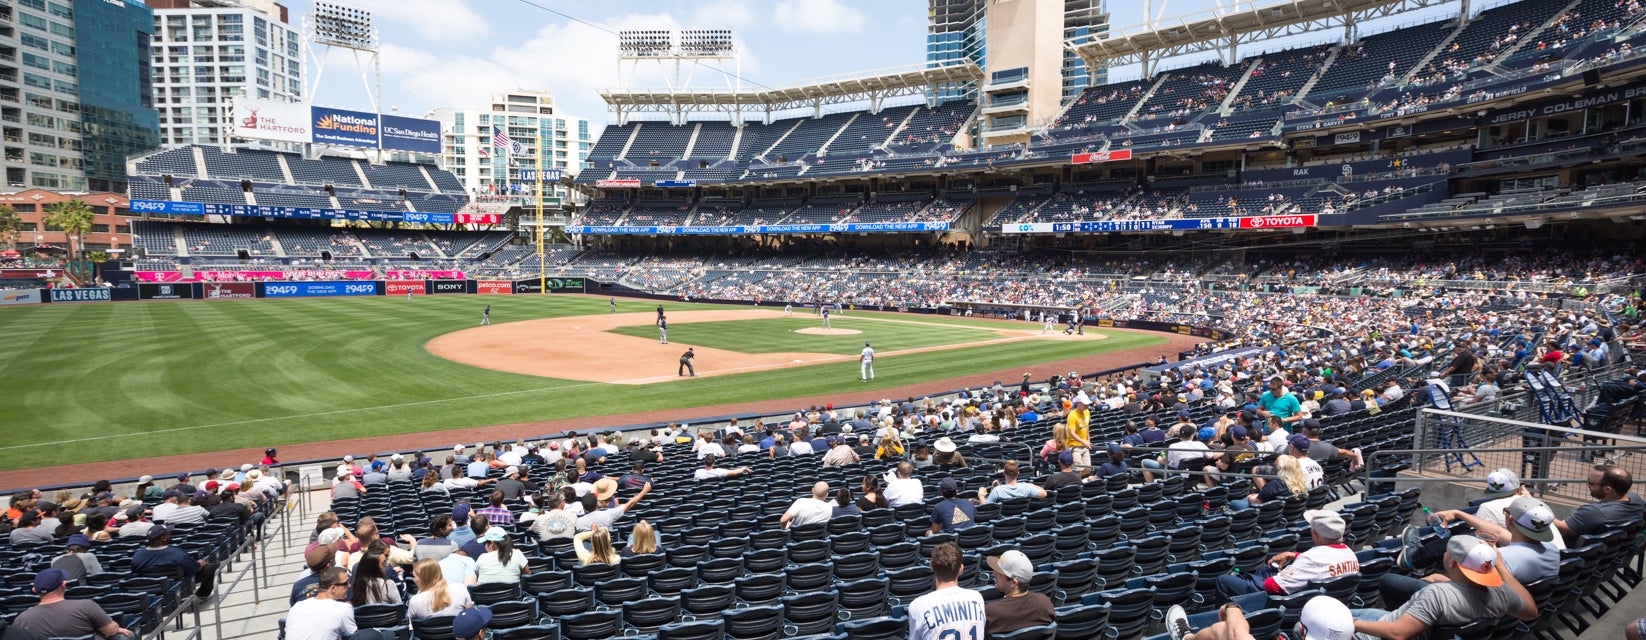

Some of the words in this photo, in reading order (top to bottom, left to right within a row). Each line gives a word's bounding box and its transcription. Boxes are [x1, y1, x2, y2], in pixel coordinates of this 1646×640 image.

[1495, 86, 1527, 98] WINFIELD
[1406, 106, 1428, 115] GWYNN
[1492, 108, 1536, 123] JERRY
[1544, 92, 1618, 114] COLEMAN
[333, 114, 376, 126] National
[260, 125, 306, 134] HARTFORD
[333, 122, 376, 135] Funding
[523, 171, 536, 180] LAS
[539, 171, 560, 180] EGAS
[1293, 168, 1309, 176] RAK
[1265, 216, 1303, 226] TOYOTA
[53, 290, 73, 300] LAS
[75, 289, 109, 299] VEGAS
